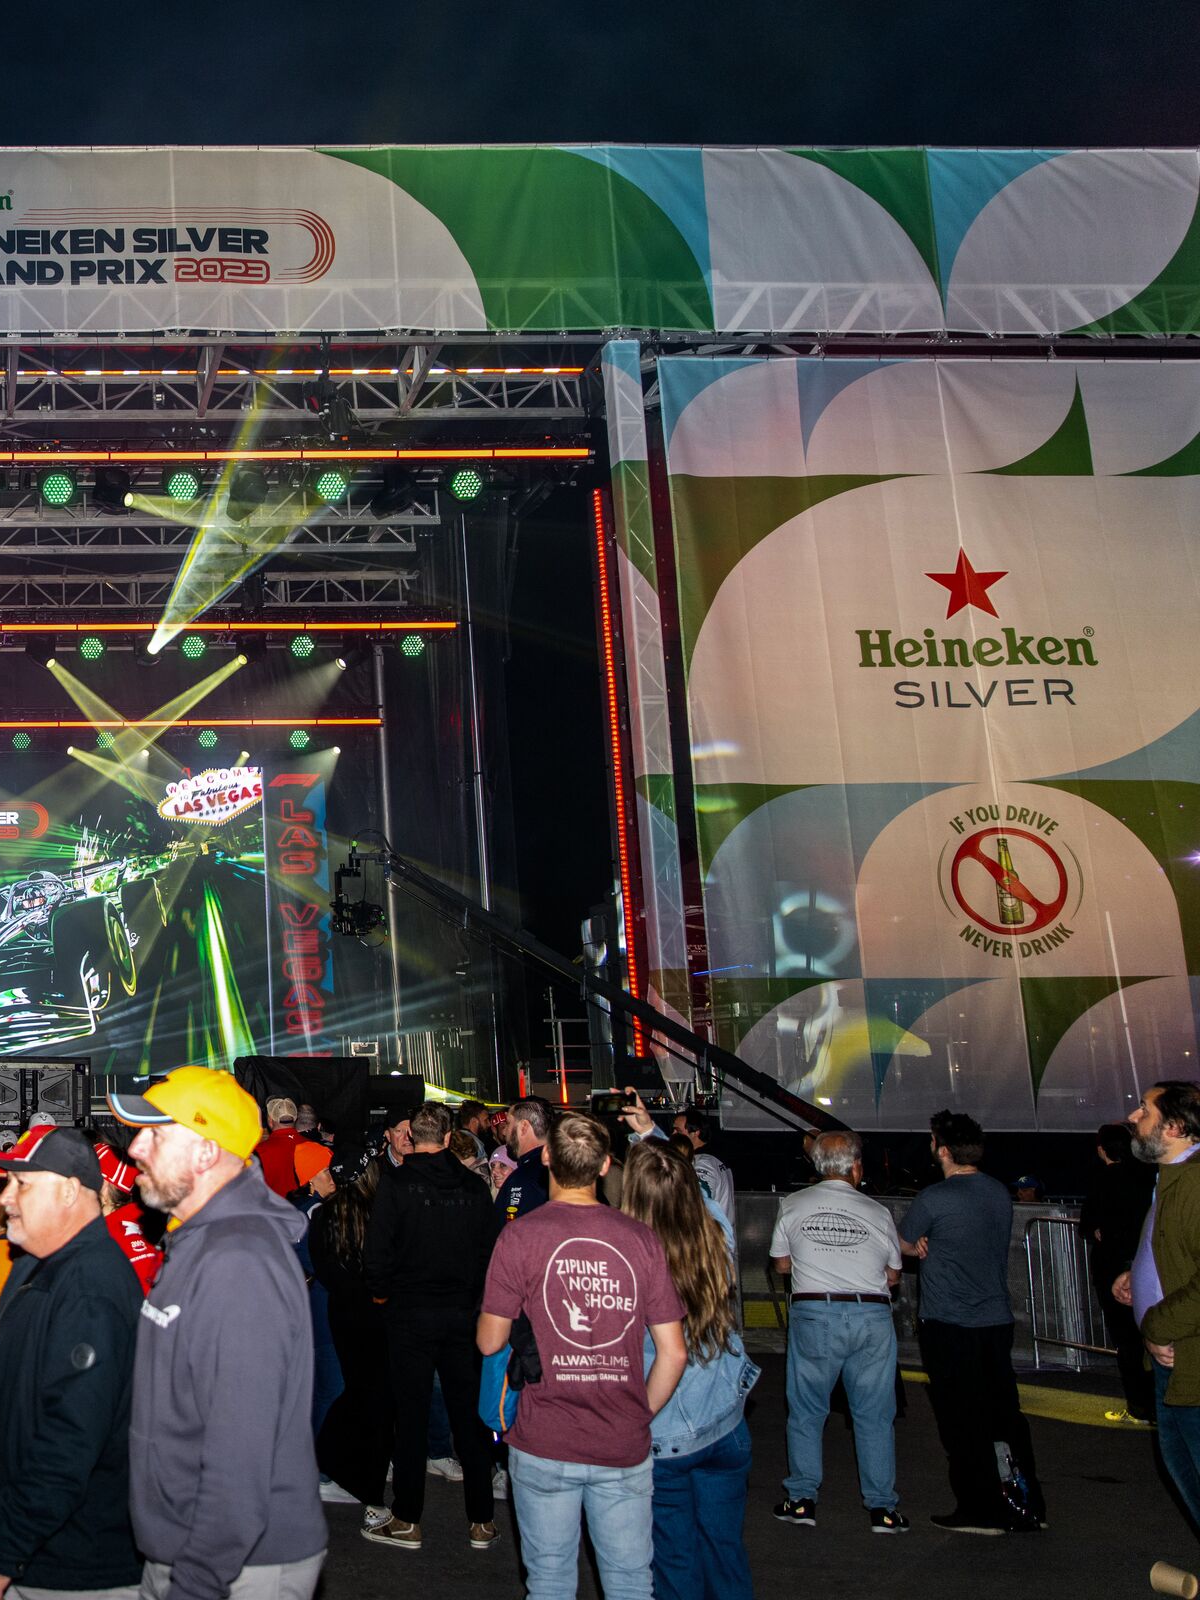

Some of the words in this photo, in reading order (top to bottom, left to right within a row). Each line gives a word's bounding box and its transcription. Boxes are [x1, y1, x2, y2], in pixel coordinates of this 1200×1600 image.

[133, 227, 268, 254] SILVER
[71, 259, 167, 285] PRIX
[173, 258, 270, 284] 2023
[854, 628, 1099, 668] Heineken
[894, 679, 1077, 708] SILVER
[174, 799, 203, 816] LAS
[206, 784, 262, 808] VEGAS
[949, 816, 967, 835] IF
[966, 805, 1000, 825] YOU
[1006, 805, 1059, 837] DRIVE
[277, 799, 318, 874] LAS
[959, 924, 1013, 959] NEVER
[1020, 922, 1074, 958] DRINK
[279, 903, 325, 1034] VEGAS
[801, 1226, 867, 1236] UNLEASHED
[555, 1259, 608, 1277] ZIPLINE
[569, 1277, 620, 1294] NORTH
[584, 1294, 633, 1312] SHORE
[556, 1373, 580, 1382] NORTH
